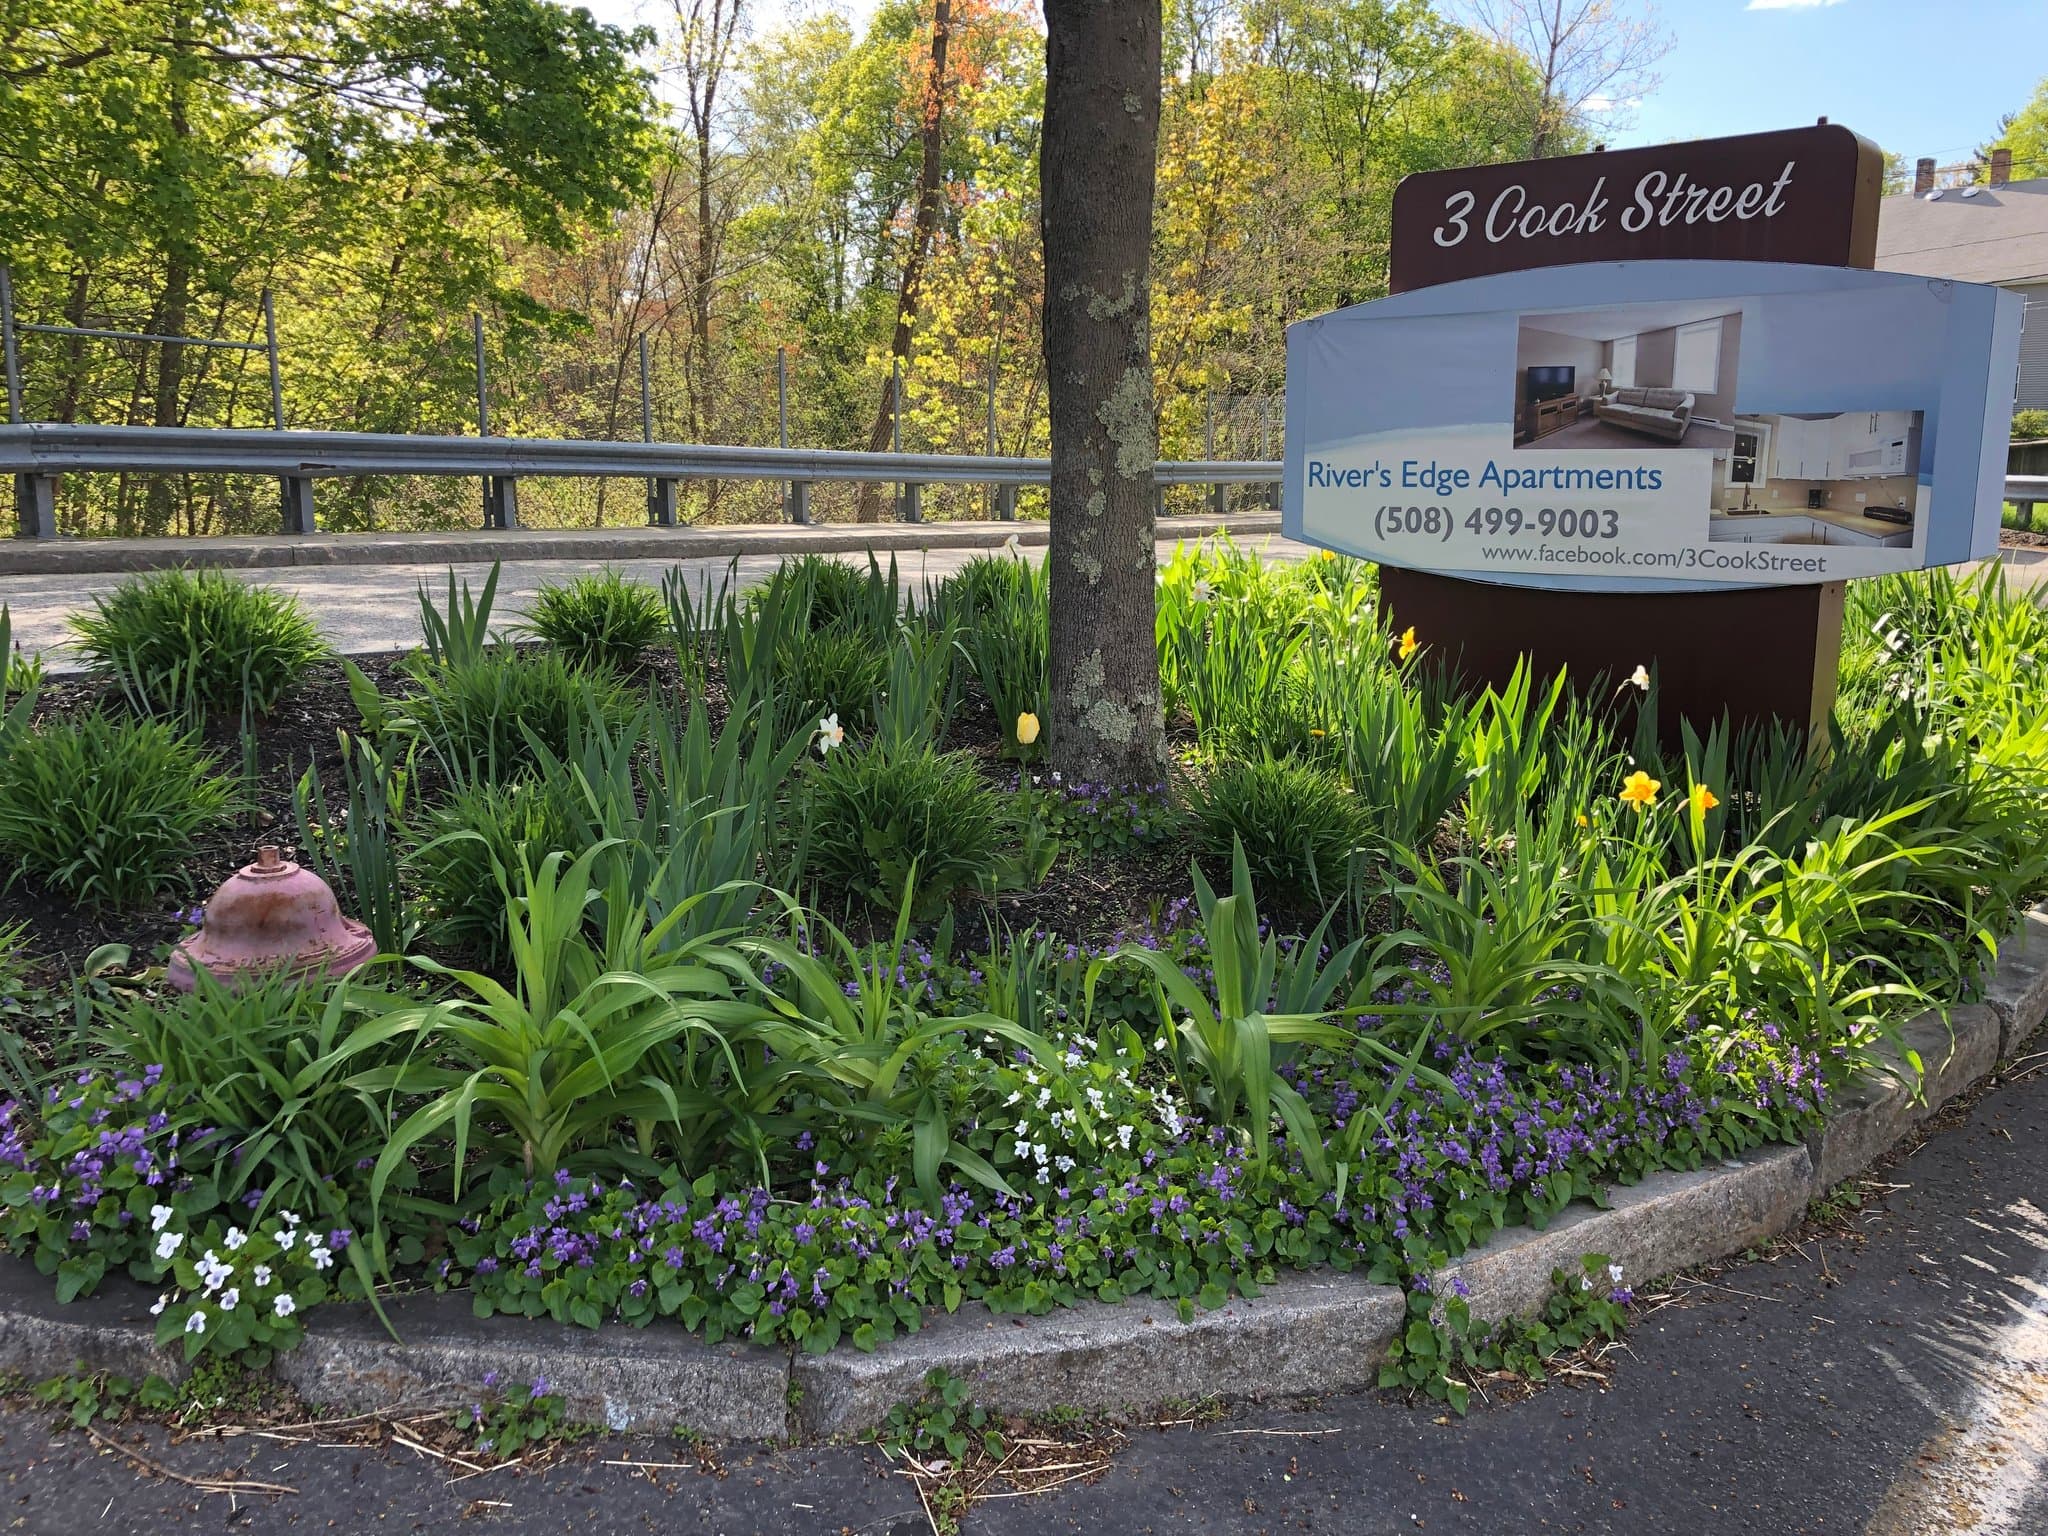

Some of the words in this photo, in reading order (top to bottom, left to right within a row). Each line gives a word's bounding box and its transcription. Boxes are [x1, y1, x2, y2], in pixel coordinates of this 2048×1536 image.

[1433, 190, 1476, 247] 3
[1484, 176, 1609, 243] Cook
[1620, 161, 1796, 233] Street
[1308, 460, 1392, 488] River's
[1402, 460, 1470, 496] Edge
[1478, 460, 1663, 496] Apartments
[1374, 506, 1454, 542] (508)
[1464, 507, 1619, 539] 499-9003
[1482, 544, 1827, 573] www.facebook.com/3CookStreet
